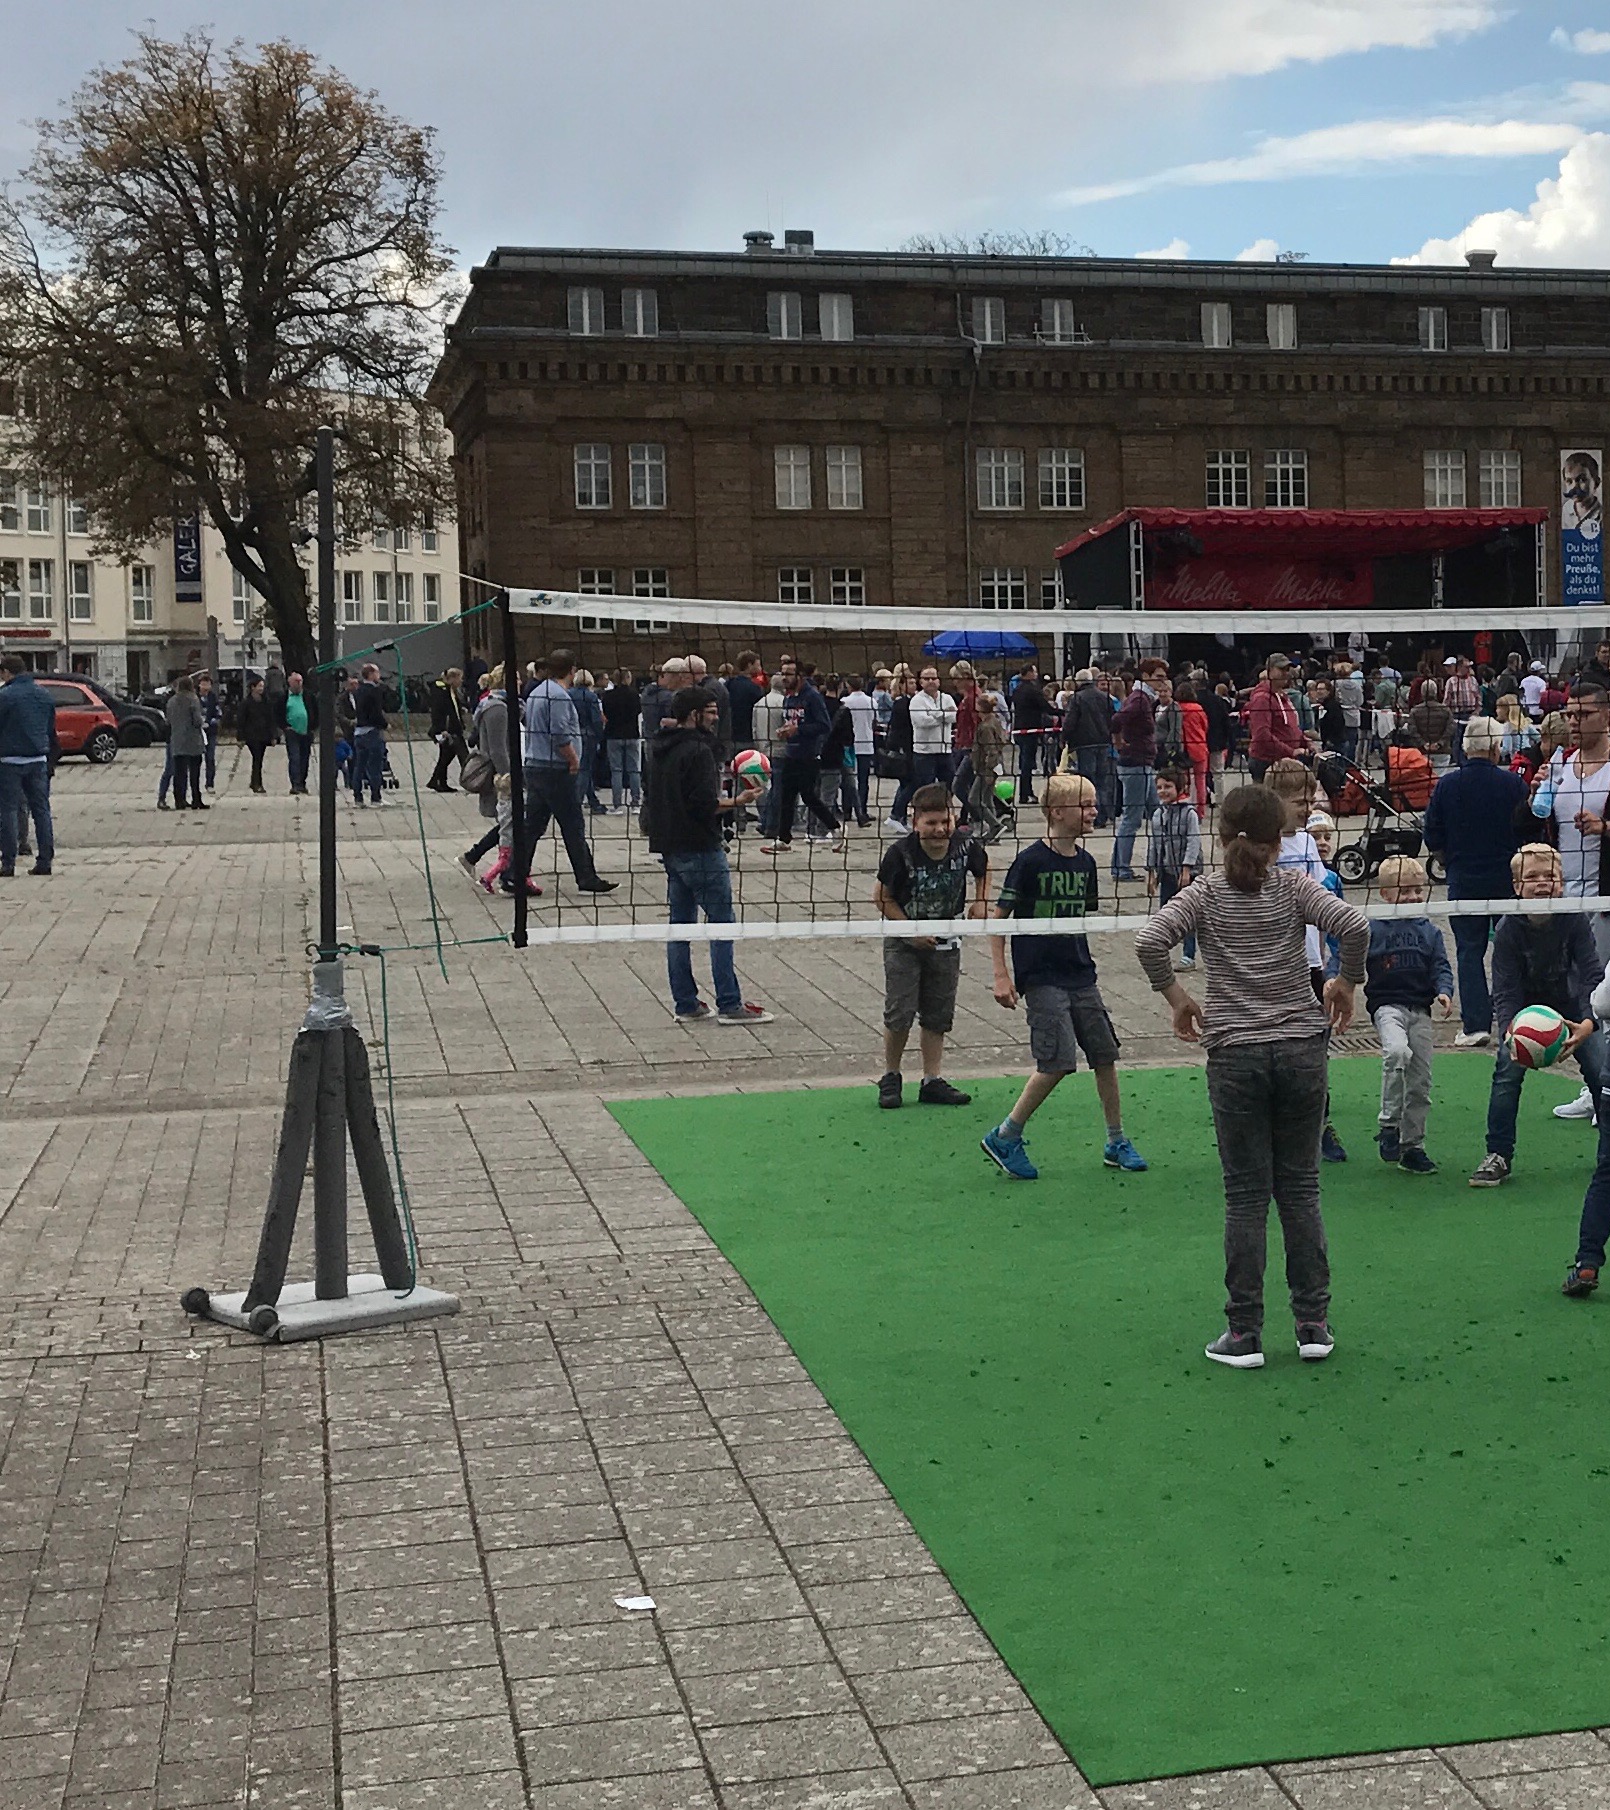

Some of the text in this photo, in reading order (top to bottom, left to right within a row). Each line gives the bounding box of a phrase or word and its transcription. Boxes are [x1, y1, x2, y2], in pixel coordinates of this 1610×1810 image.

[1566, 542, 1599, 553] Du bist
[1570, 553, 1595, 563] mehr
[1161, 564, 1346, 603] Melitta Melitta
[1569, 574, 1597, 584] als du
[1566, 585, 1600, 595] denkst!
[1037, 871, 1089, 896] TRUS
